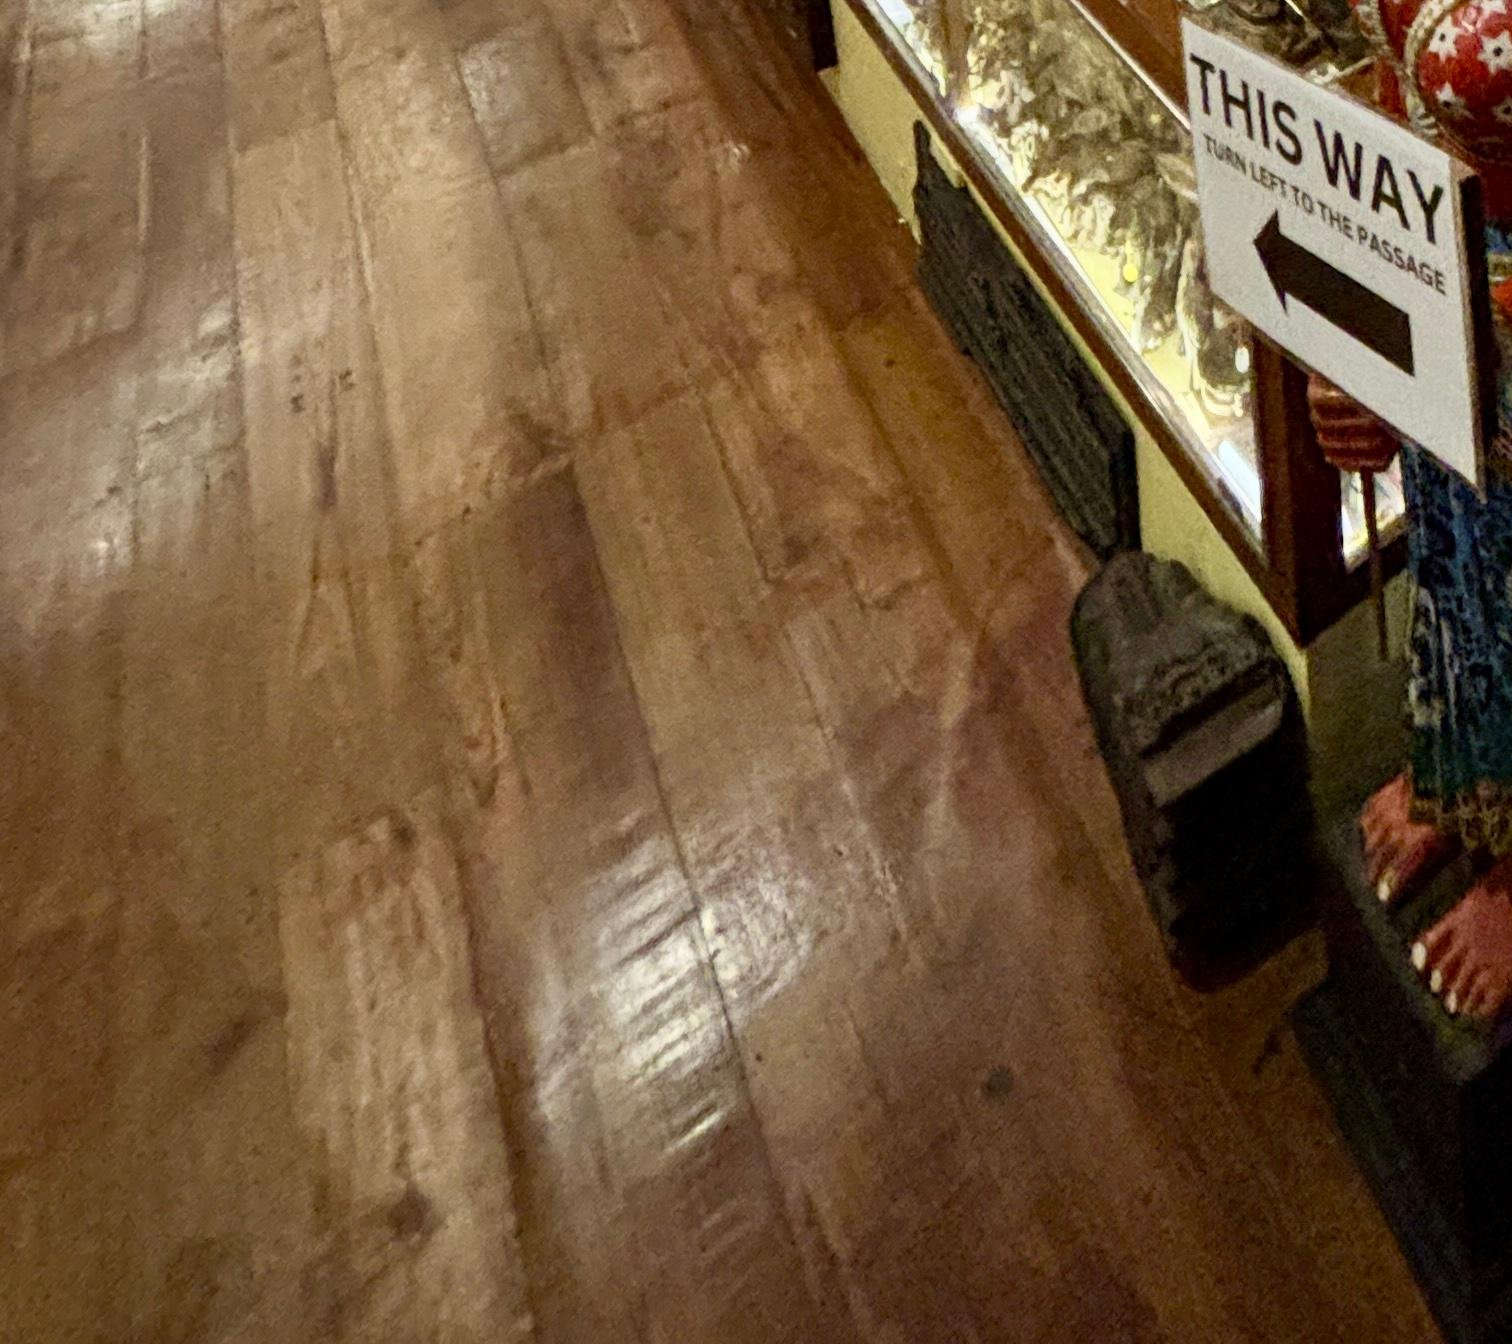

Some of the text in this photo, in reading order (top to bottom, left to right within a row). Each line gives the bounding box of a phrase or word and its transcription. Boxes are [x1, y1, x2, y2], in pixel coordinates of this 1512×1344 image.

[1190, 52, 1444, 246] THIS WAY
[1203, 132, 1446, 296] TURN LEFT TO THE PASSAGE
